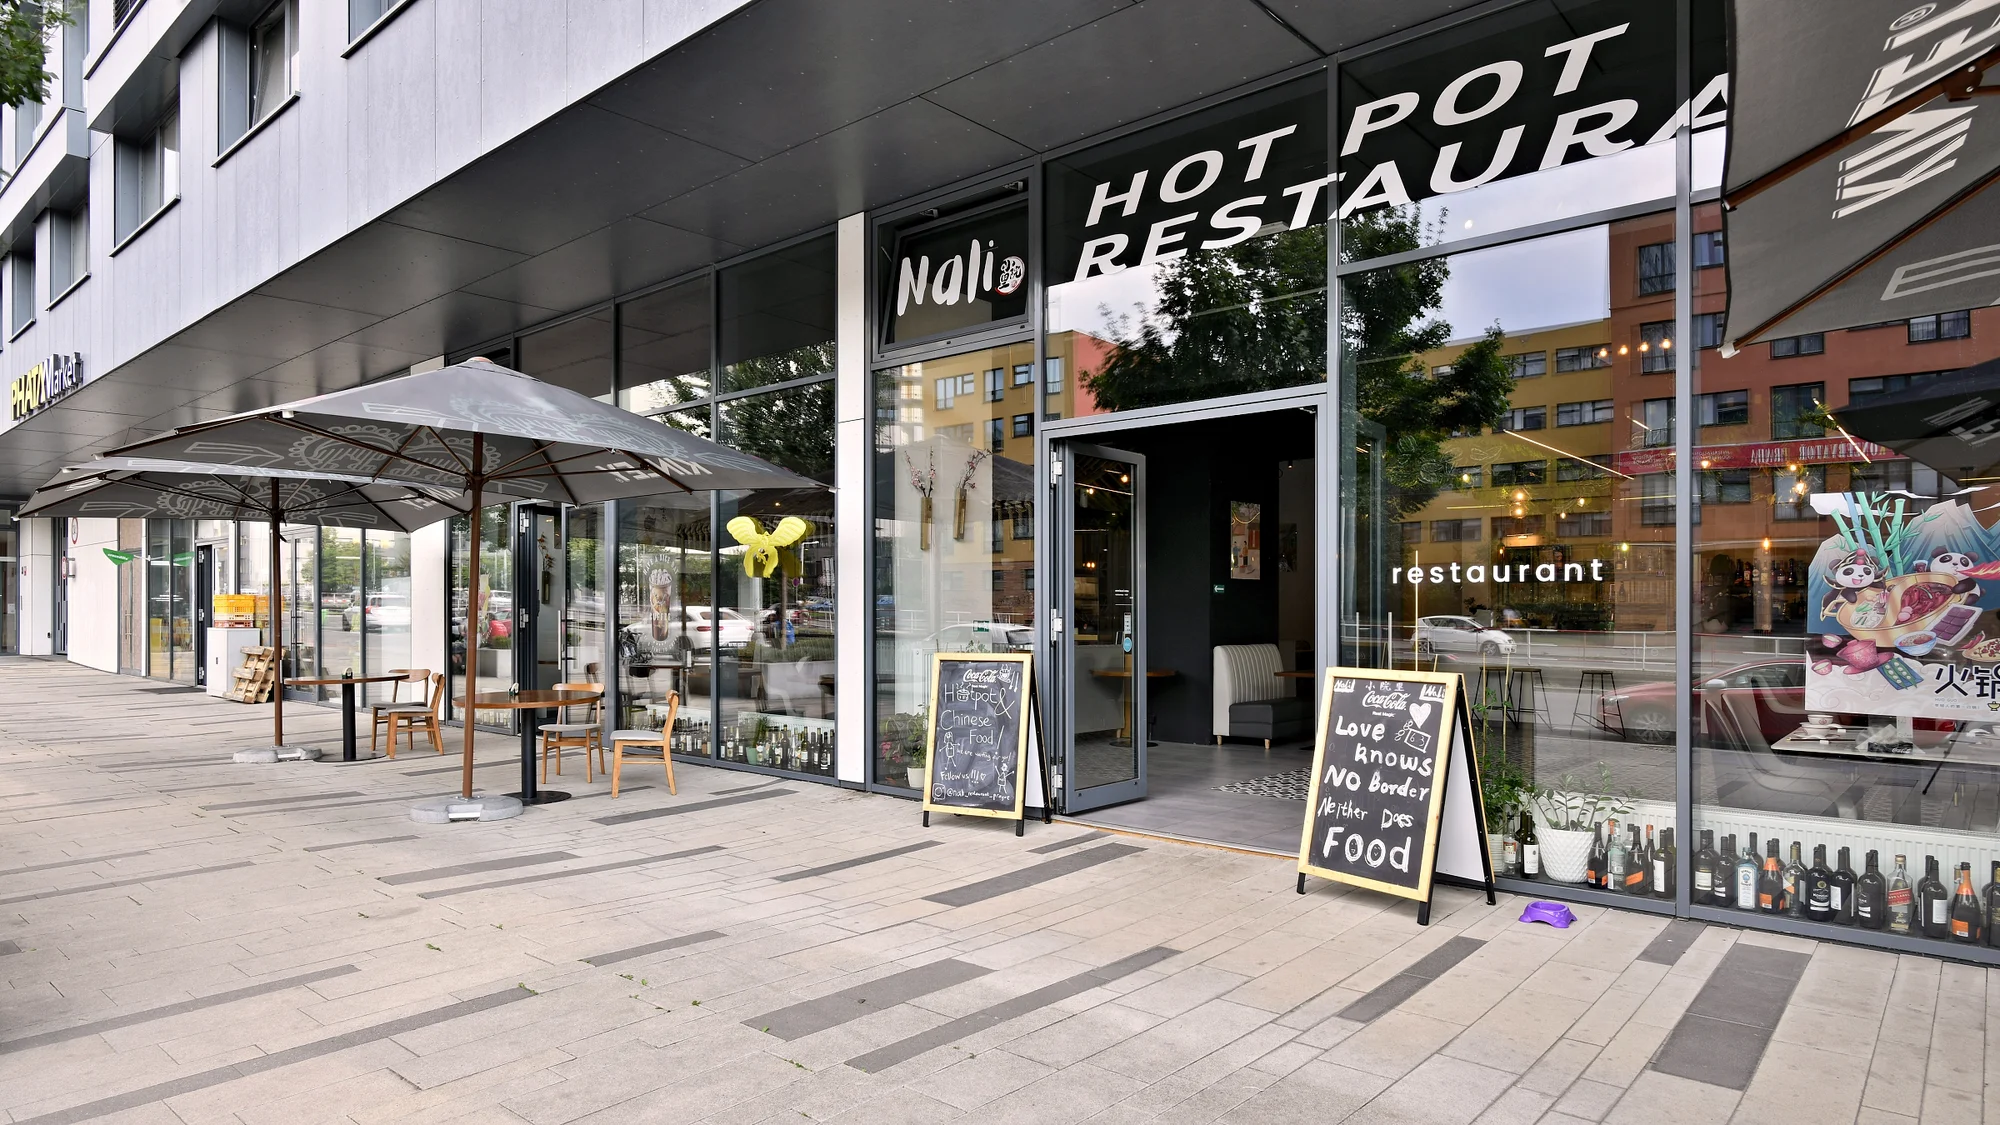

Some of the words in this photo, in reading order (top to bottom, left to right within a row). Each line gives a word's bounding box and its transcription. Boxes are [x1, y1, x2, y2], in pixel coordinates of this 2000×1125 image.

[1085, 124, 1297, 227] HOT
[1341, 22, 1630, 157] POT
[897, 239, 994, 317] Nali
[1392, 558, 1603, 584] restaurant
[993, 687, 1015, 719] &
[1362, 690, 1411, 711] Coca-Cola
[940, 709, 992, 731] Chinese
[1335, 715, 1386, 742] Love
[1323, 765, 1362, 791] NO
[1368, 770, 1431, 802] Border
